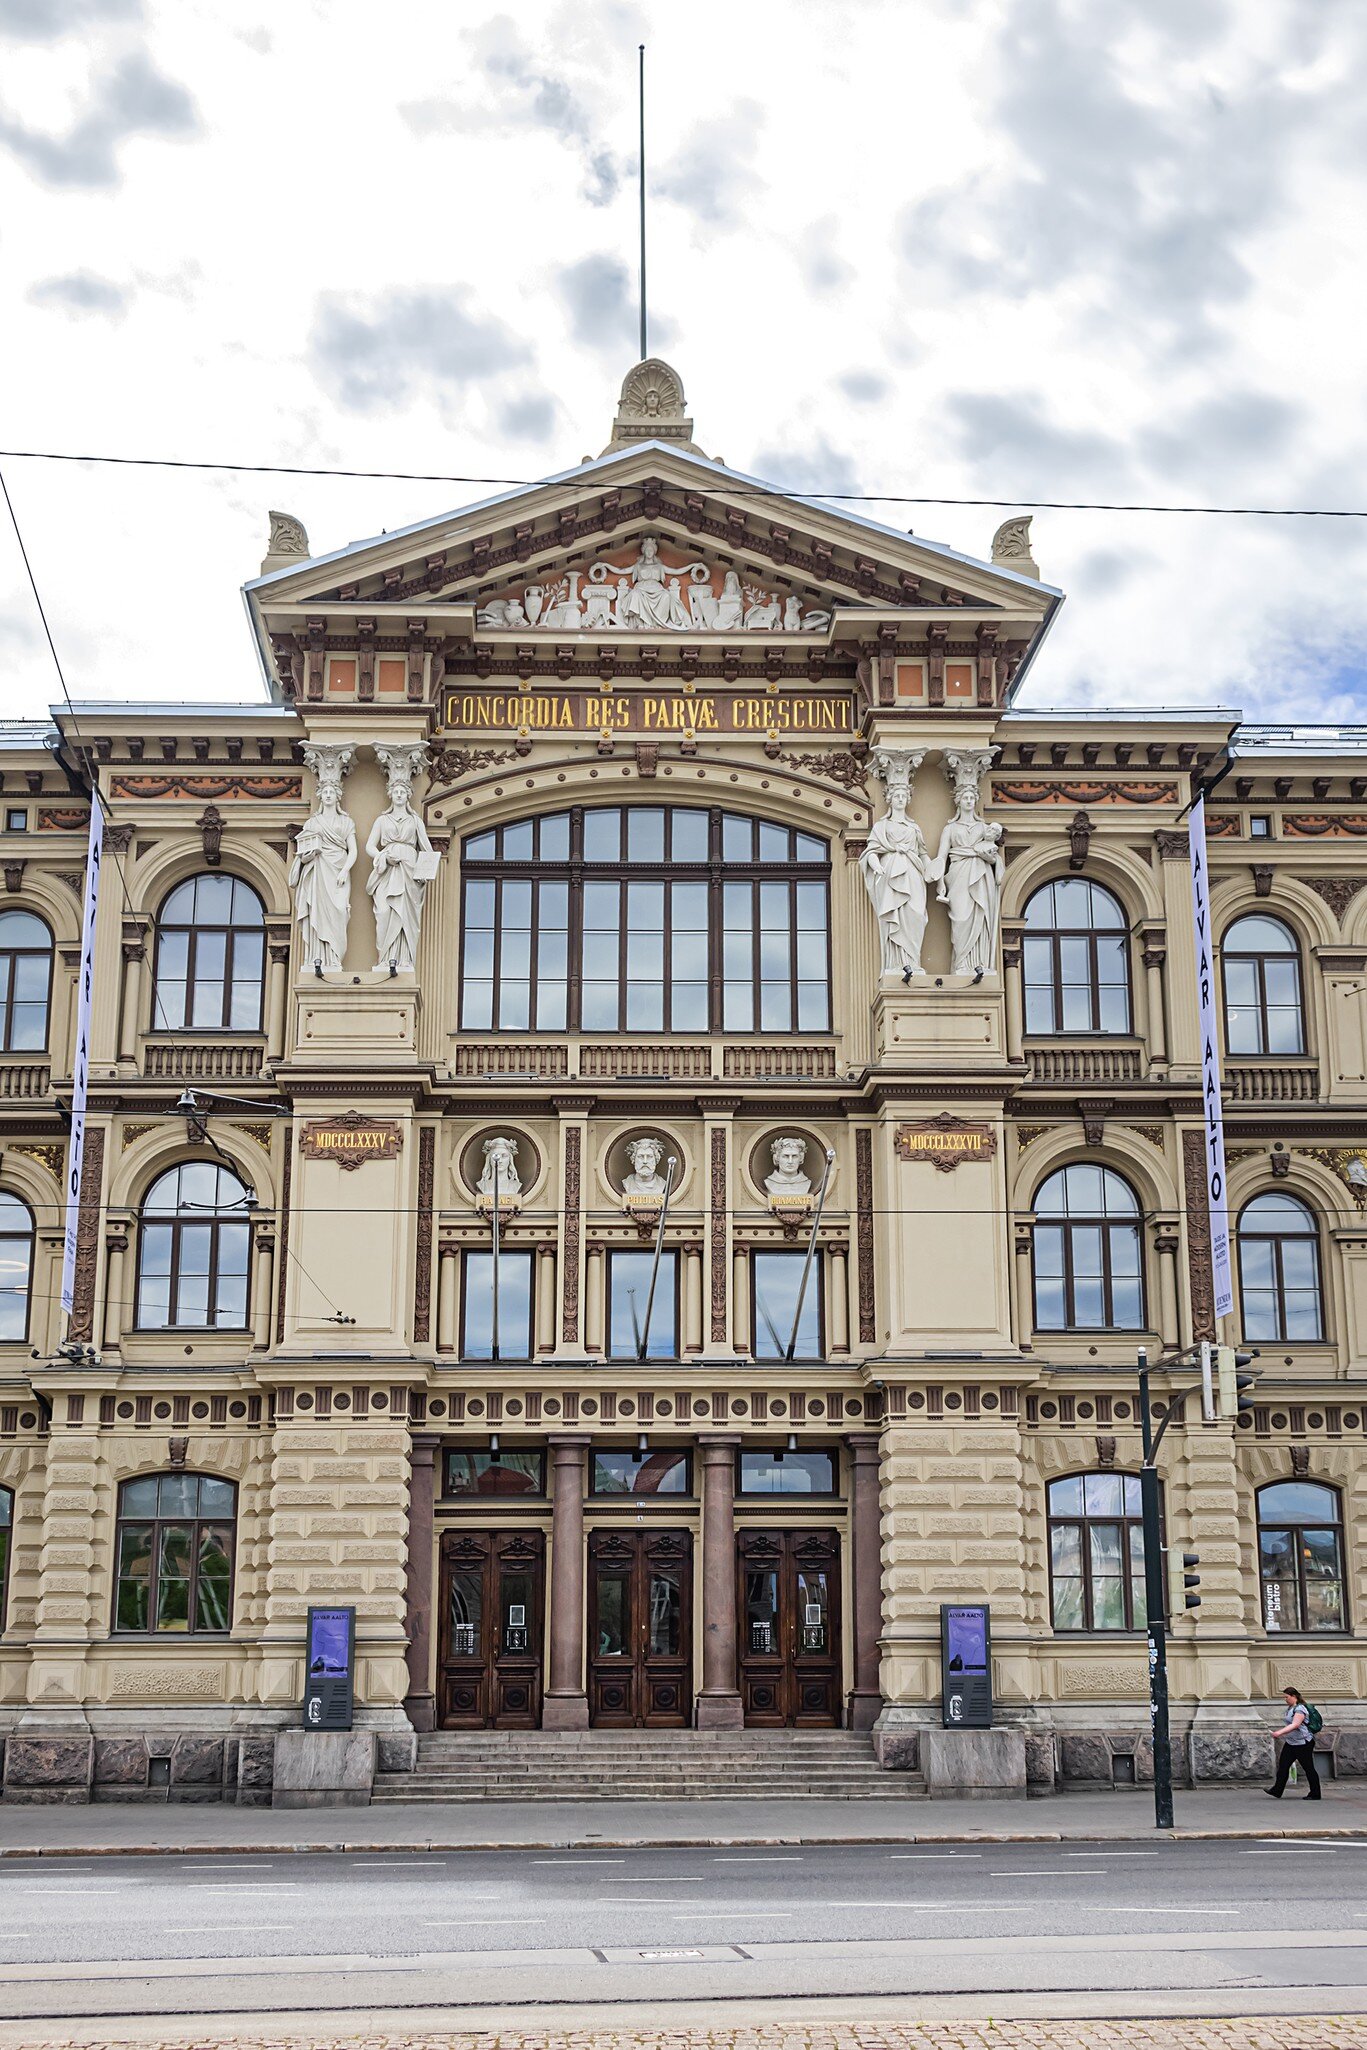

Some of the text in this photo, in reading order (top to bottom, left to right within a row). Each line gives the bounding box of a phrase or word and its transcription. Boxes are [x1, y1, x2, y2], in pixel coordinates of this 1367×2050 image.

[447, 696, 850, 729] CONCORDIA RES PARVÆ CRESCUNT
[1193, 848, 1222, 1202] ALVAR AALTO
[71, 1029, 87, 1198] AATO
[315, 1132, 387, 1149] MDCCCLXXXV
[909, 1134, 982, 1150] MDCCCLXXXVII
[481, 1195, 516, 1205] RAAEL
[627, 1195, 664, 1205] PHIDIAS
[1273, 1583, 1281, 1612] bistro
